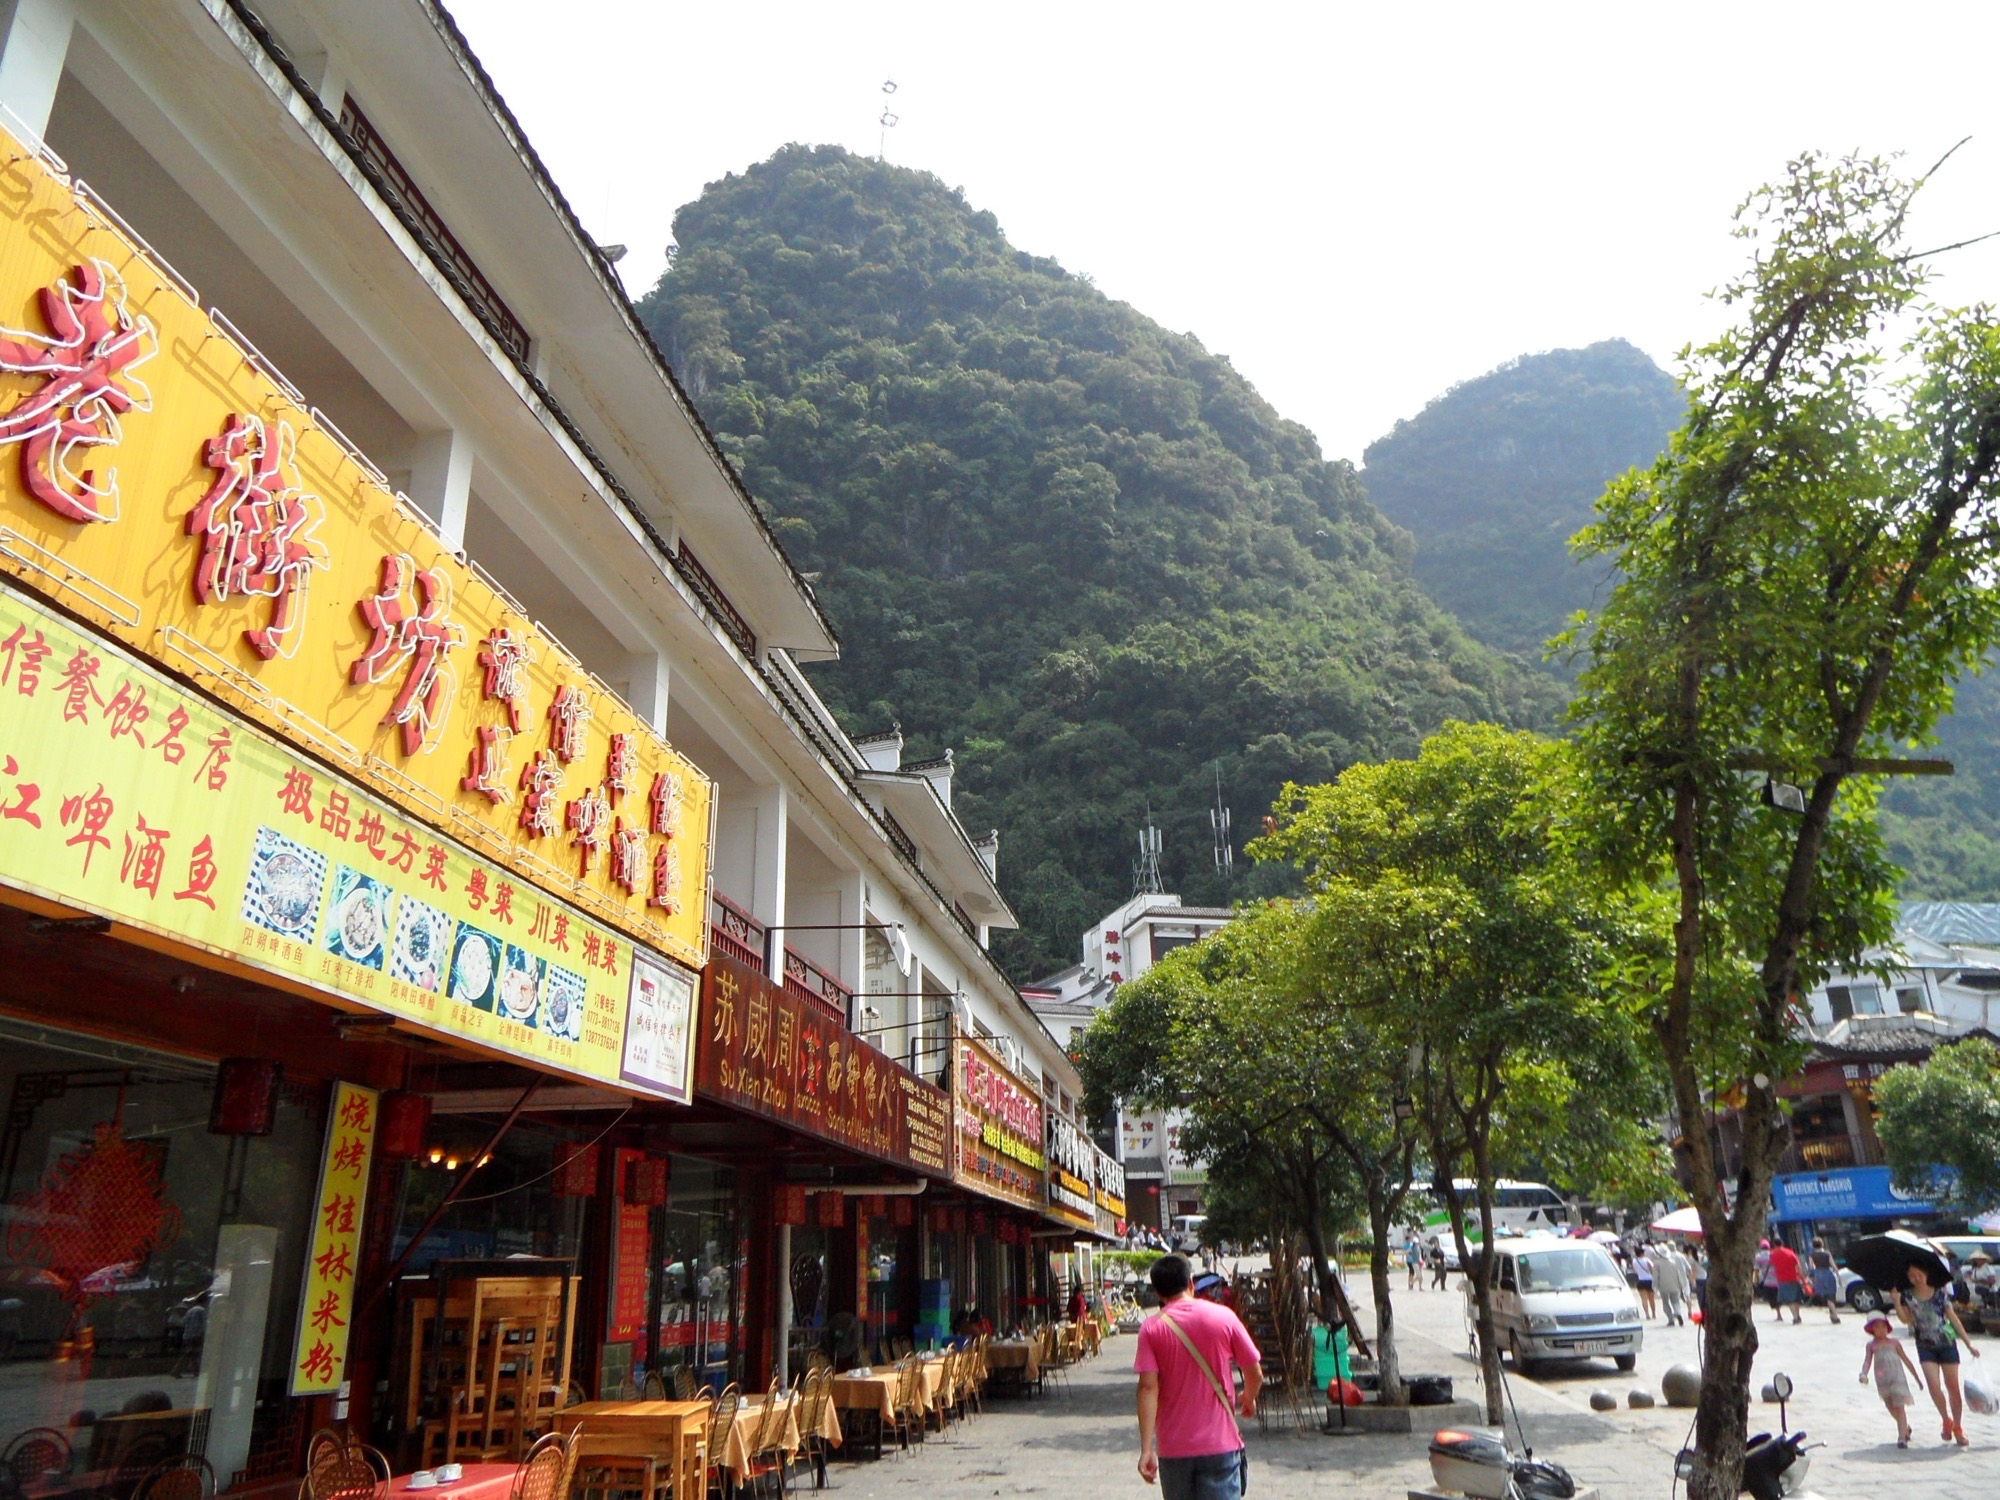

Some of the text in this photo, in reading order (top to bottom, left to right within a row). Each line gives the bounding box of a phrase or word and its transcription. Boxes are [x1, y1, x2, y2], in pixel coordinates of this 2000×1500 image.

[1, 622, 233, 793] 信餐饮名店
[242, 927, 303, 966] 阳朔啤酒鱼
[278, 766, 618, 976] 极品地方菜 粤菜 川菜 湘菜
[720, 1058, 735, 1089] Su
[737, 1067, 760, 1099] Xian
[763, 1077, 787, 1110] Zhou
[300, 1192, 353, 1385] 桂林米粉
